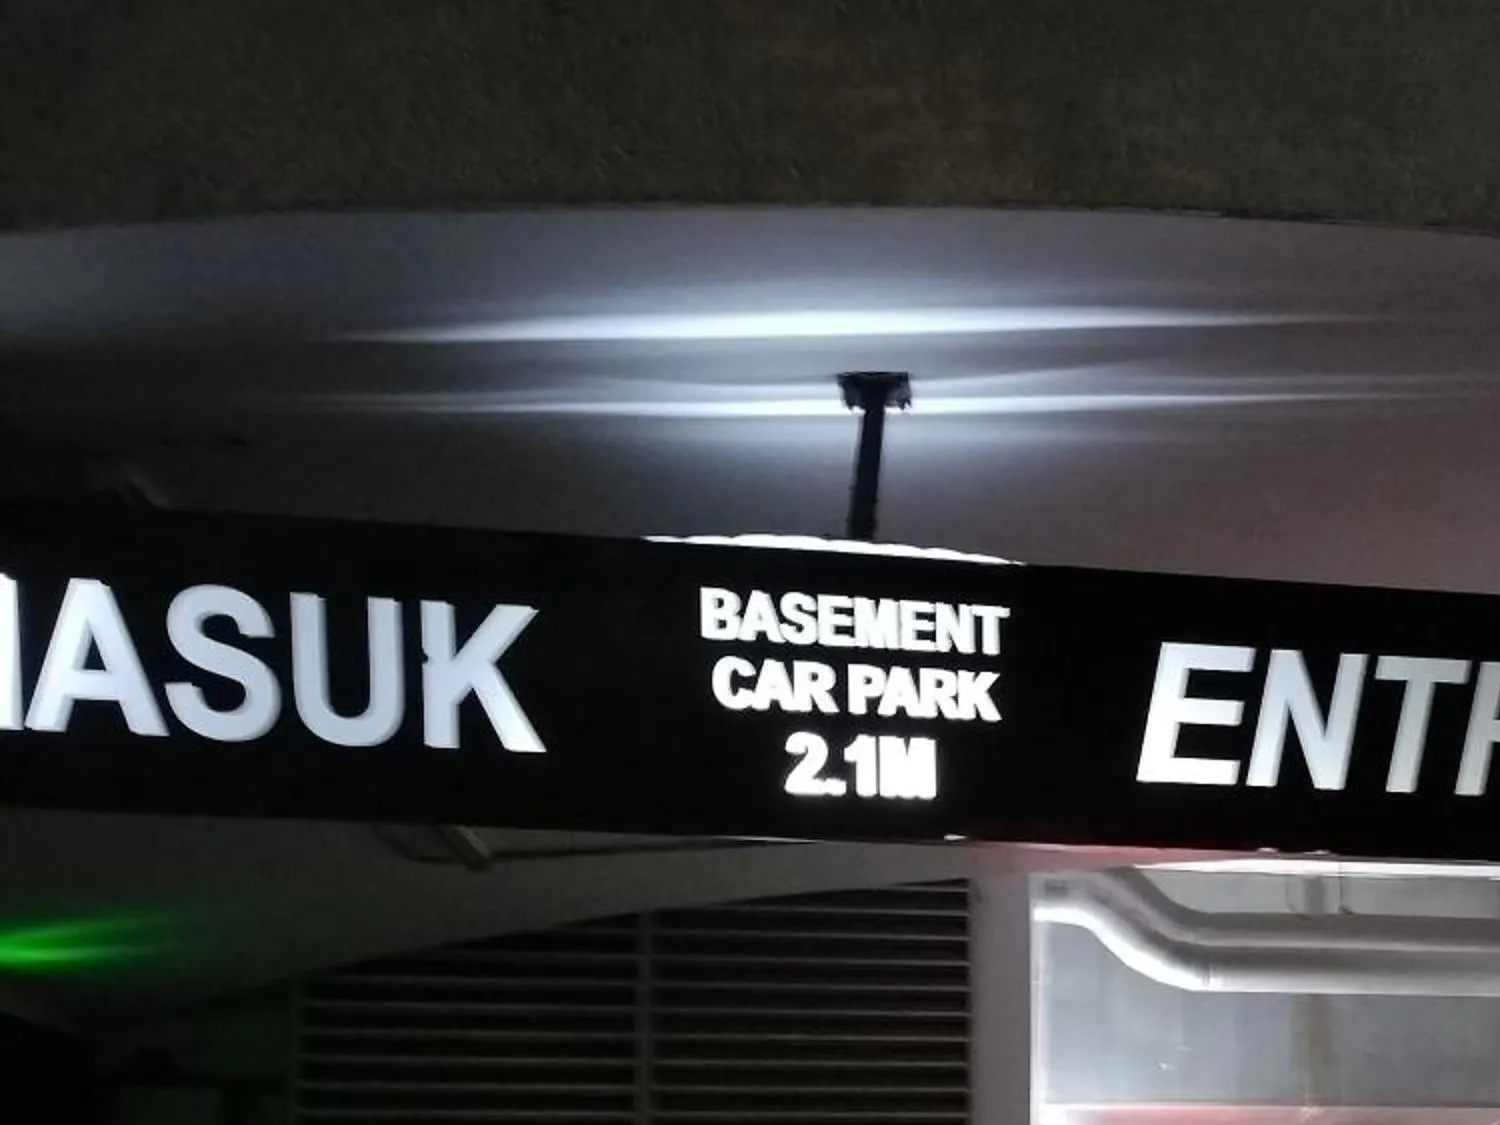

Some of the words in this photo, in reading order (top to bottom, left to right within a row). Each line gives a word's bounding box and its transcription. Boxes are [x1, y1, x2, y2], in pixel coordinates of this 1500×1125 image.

[700, 587, 1010, 655] BASEMENT
[712, 655, 839, 712] CAR
[848, 663, 1002, 721] PARK
[784, 731, 937, 799] 2.1M
